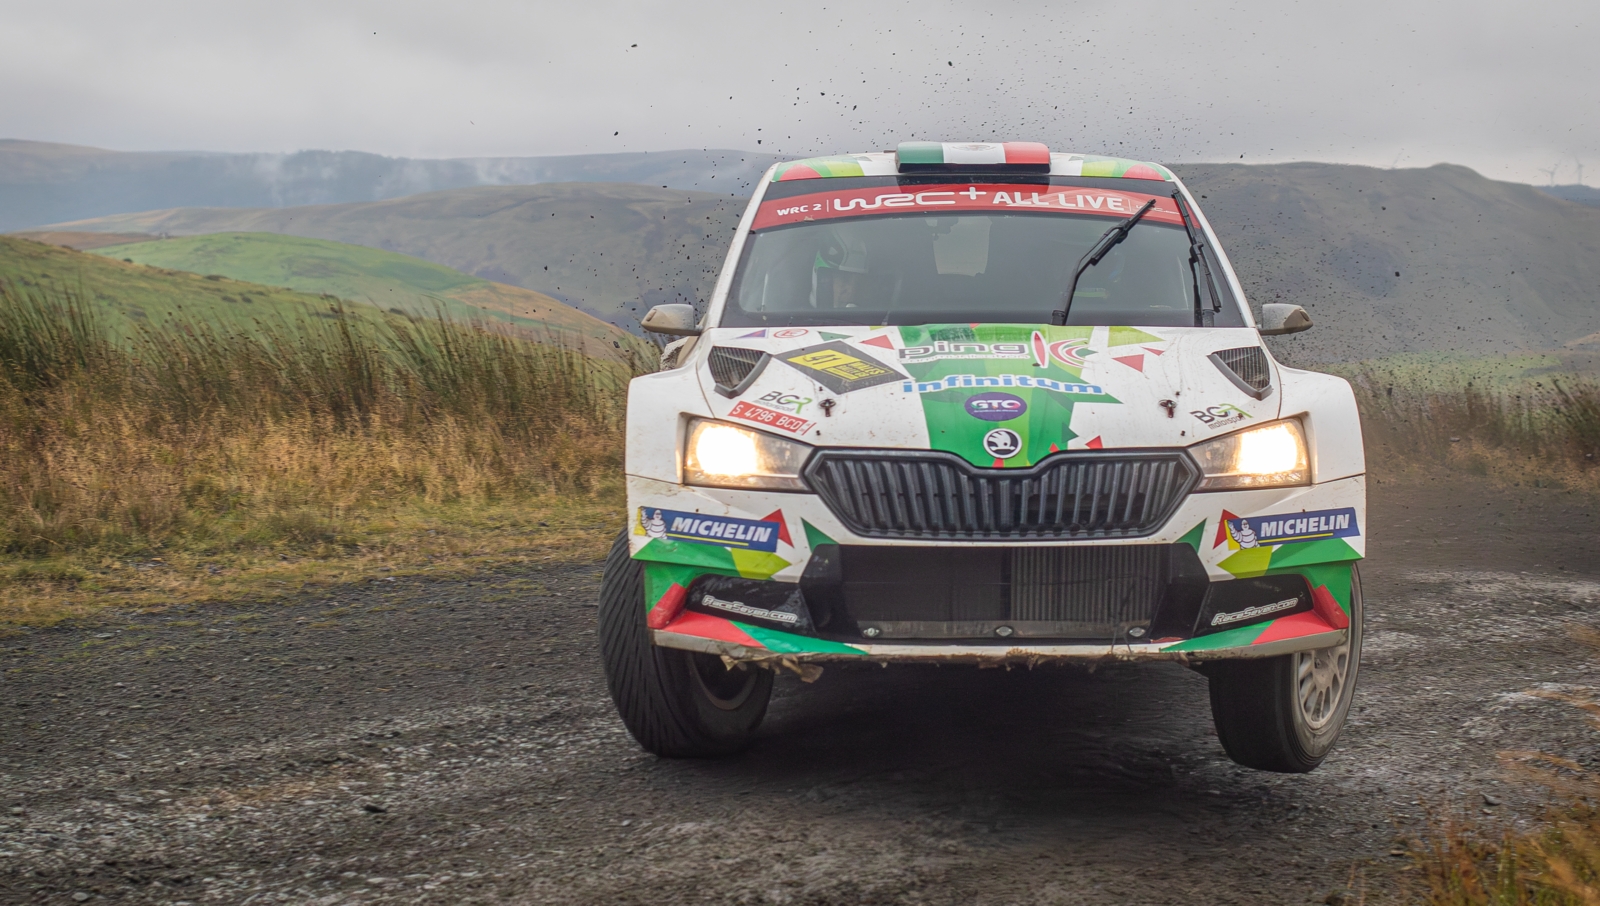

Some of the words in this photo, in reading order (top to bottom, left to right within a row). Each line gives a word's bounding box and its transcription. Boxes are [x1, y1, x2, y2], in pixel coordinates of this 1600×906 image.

[776, 204, 809, 216] WRC
[812, 203, 822, 211] 2
[992, 191, 1050, 206] ALL
[1058, 193, 1125, 211] LIVE
[898, 341, 1029, 358] ping
[903, 375, 1103, 394] infinitum
[970, 399, 1021, 410] GTO
[732, 404, 744, 415] S
[744, 407, 777, 423] 4796
[776, 416, 804, 430] BCD
[670, 516, 773, 543] MICHELIN
[1260, 513, 1350, 538] MICHELIN
[702, 594, 798, 623] RaceSeven.com
[1211, 597, 1299, 627] RaceSeven.com
